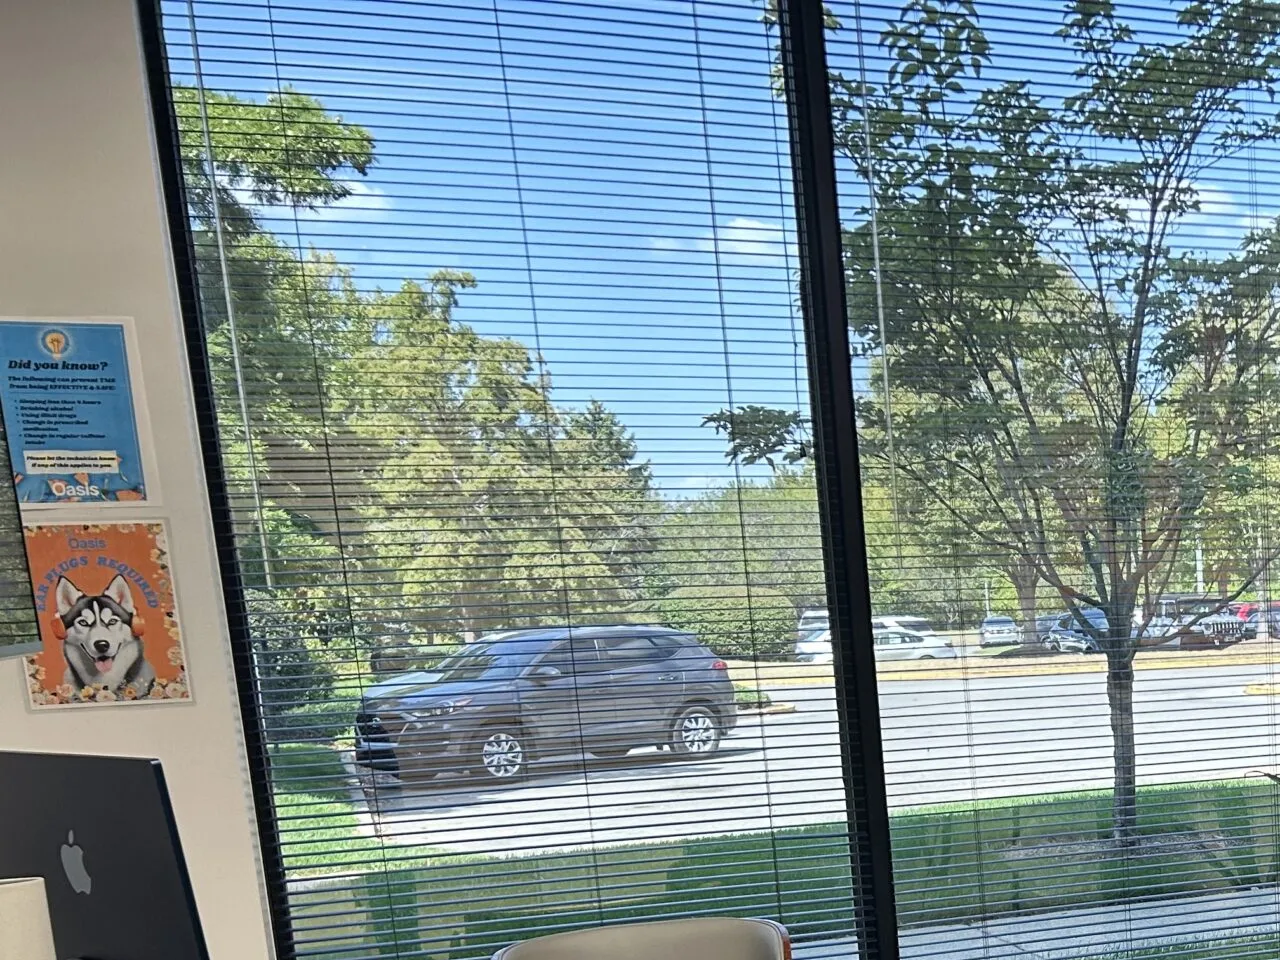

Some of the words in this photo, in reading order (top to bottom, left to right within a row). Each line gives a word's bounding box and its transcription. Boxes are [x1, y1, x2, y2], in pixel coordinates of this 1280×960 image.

[8, 360, 31, 369] Did
[34, 361, 59, 371] you
[61, 361, 108, 371] know?
[53, 482, 100, 496] Oasis
[68, 538, 107, 549] Oasis
[36, 584, 50, 612] EAR
[44, 556, 89, 582] PLUGS
[97, 556, 159, 609] REQUIRED
